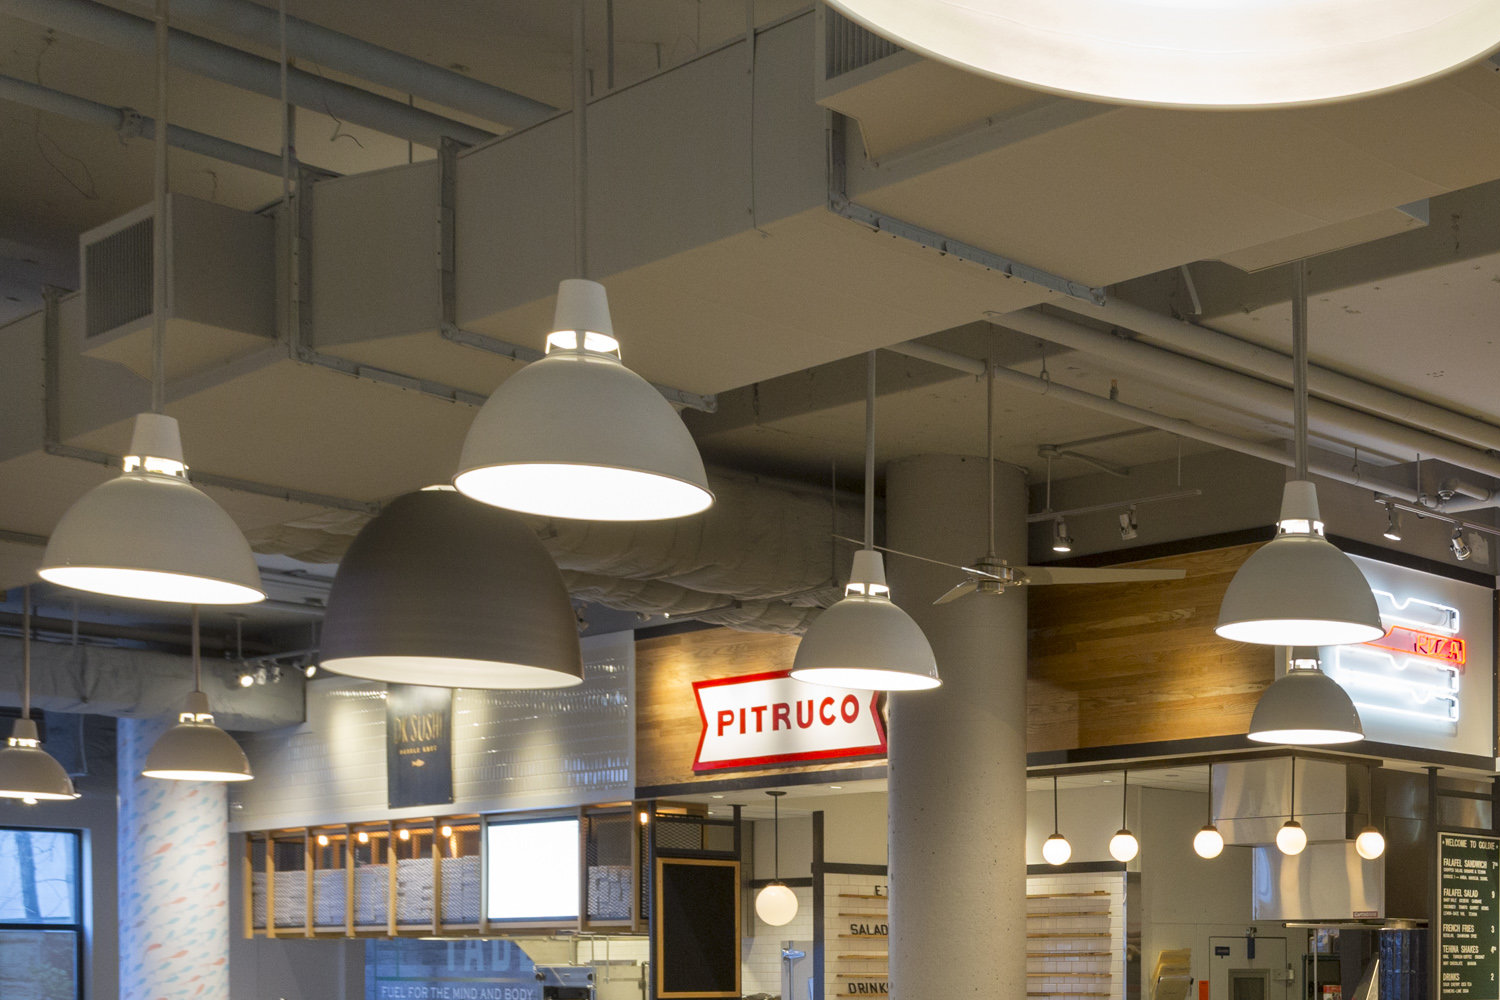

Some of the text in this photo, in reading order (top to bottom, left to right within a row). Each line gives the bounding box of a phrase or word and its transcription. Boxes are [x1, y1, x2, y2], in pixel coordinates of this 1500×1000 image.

[717, 694, 860, 737] PITRUCO
[410, 711, 443, 743] SUSHI
[1444, 838, 1496, 850] WELCOME TO GOLDIE
[1443, 857, 1462, 867] FALAFEL
[1464, 859, 1487, 869] SANDWICH
[1443, 888, 1463, 897] FALAFEL
[1463, 889, 1478, 898] SALAD
[1443, 924, 1495, 934] FRENCH FRIES 3
[1461, 945, 1479, 954] SHAKES
[1443, 973, 1494, 981] DRINKS 2
[381, 986, 534, 1000] FUEL FOR THE MIND AND BODY
